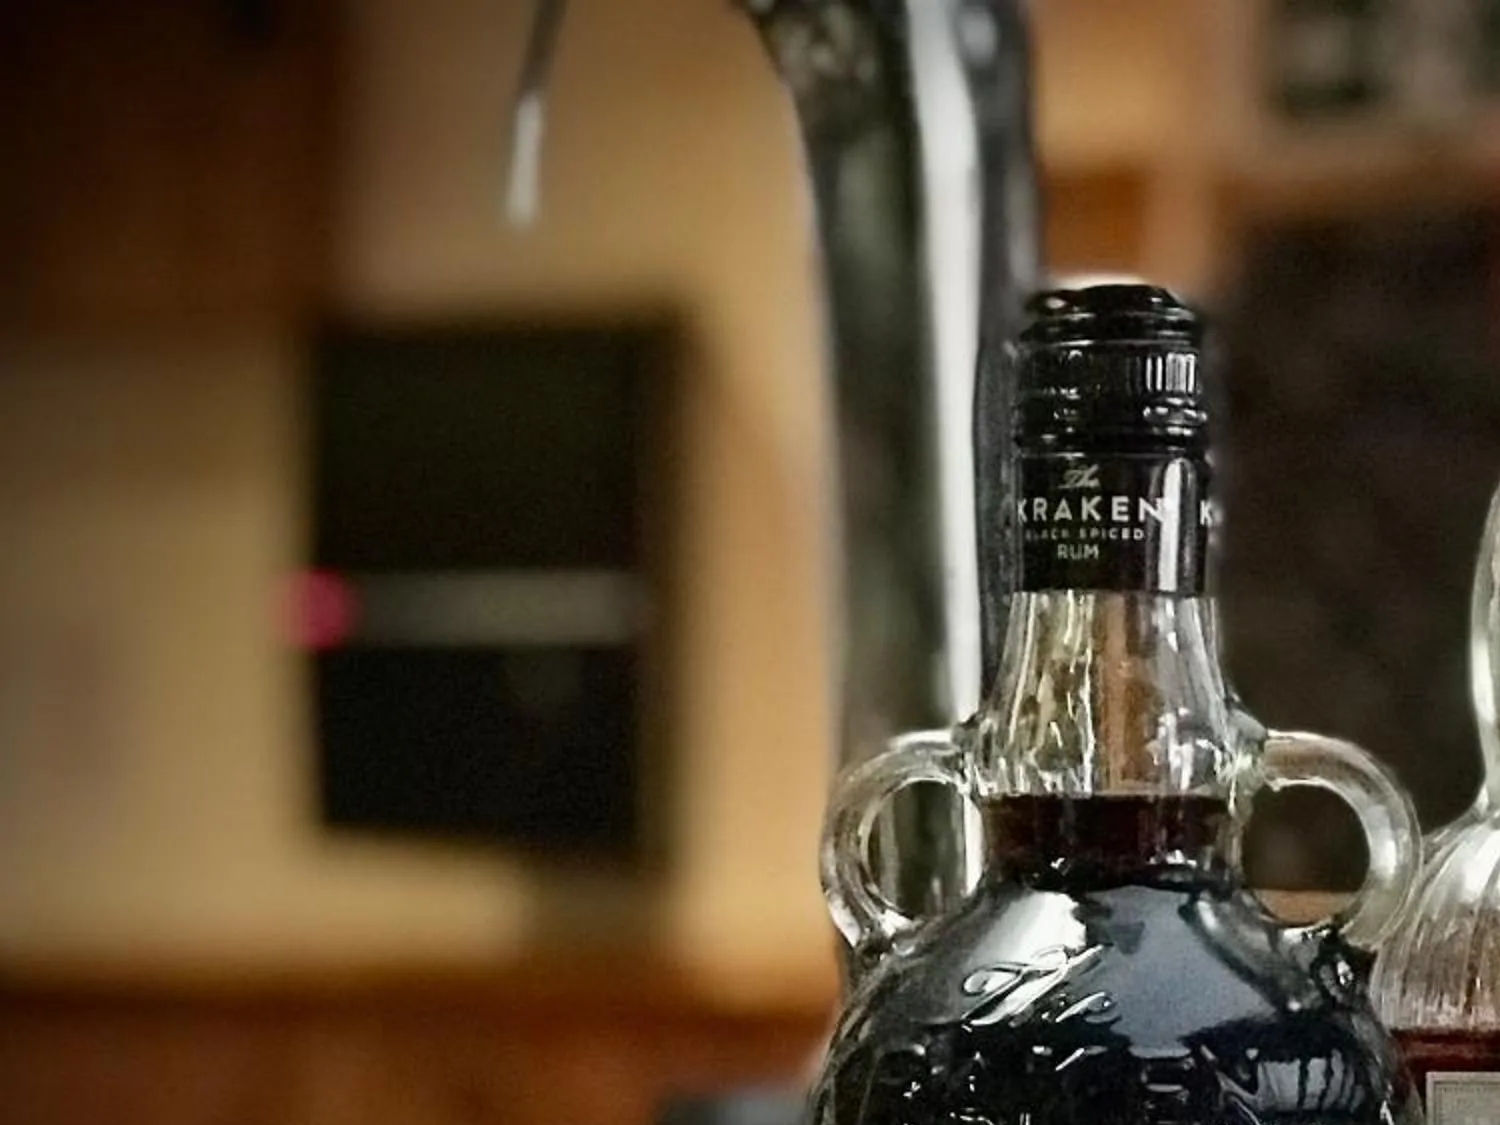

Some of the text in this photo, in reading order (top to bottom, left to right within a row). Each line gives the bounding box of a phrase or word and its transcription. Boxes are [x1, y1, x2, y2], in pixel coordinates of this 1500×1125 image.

[1016, 495, 1166, 523] KRAKEN
[1079, 527, 1145, 541] SPICED
[1057, 543, 1100, 560] RUM
